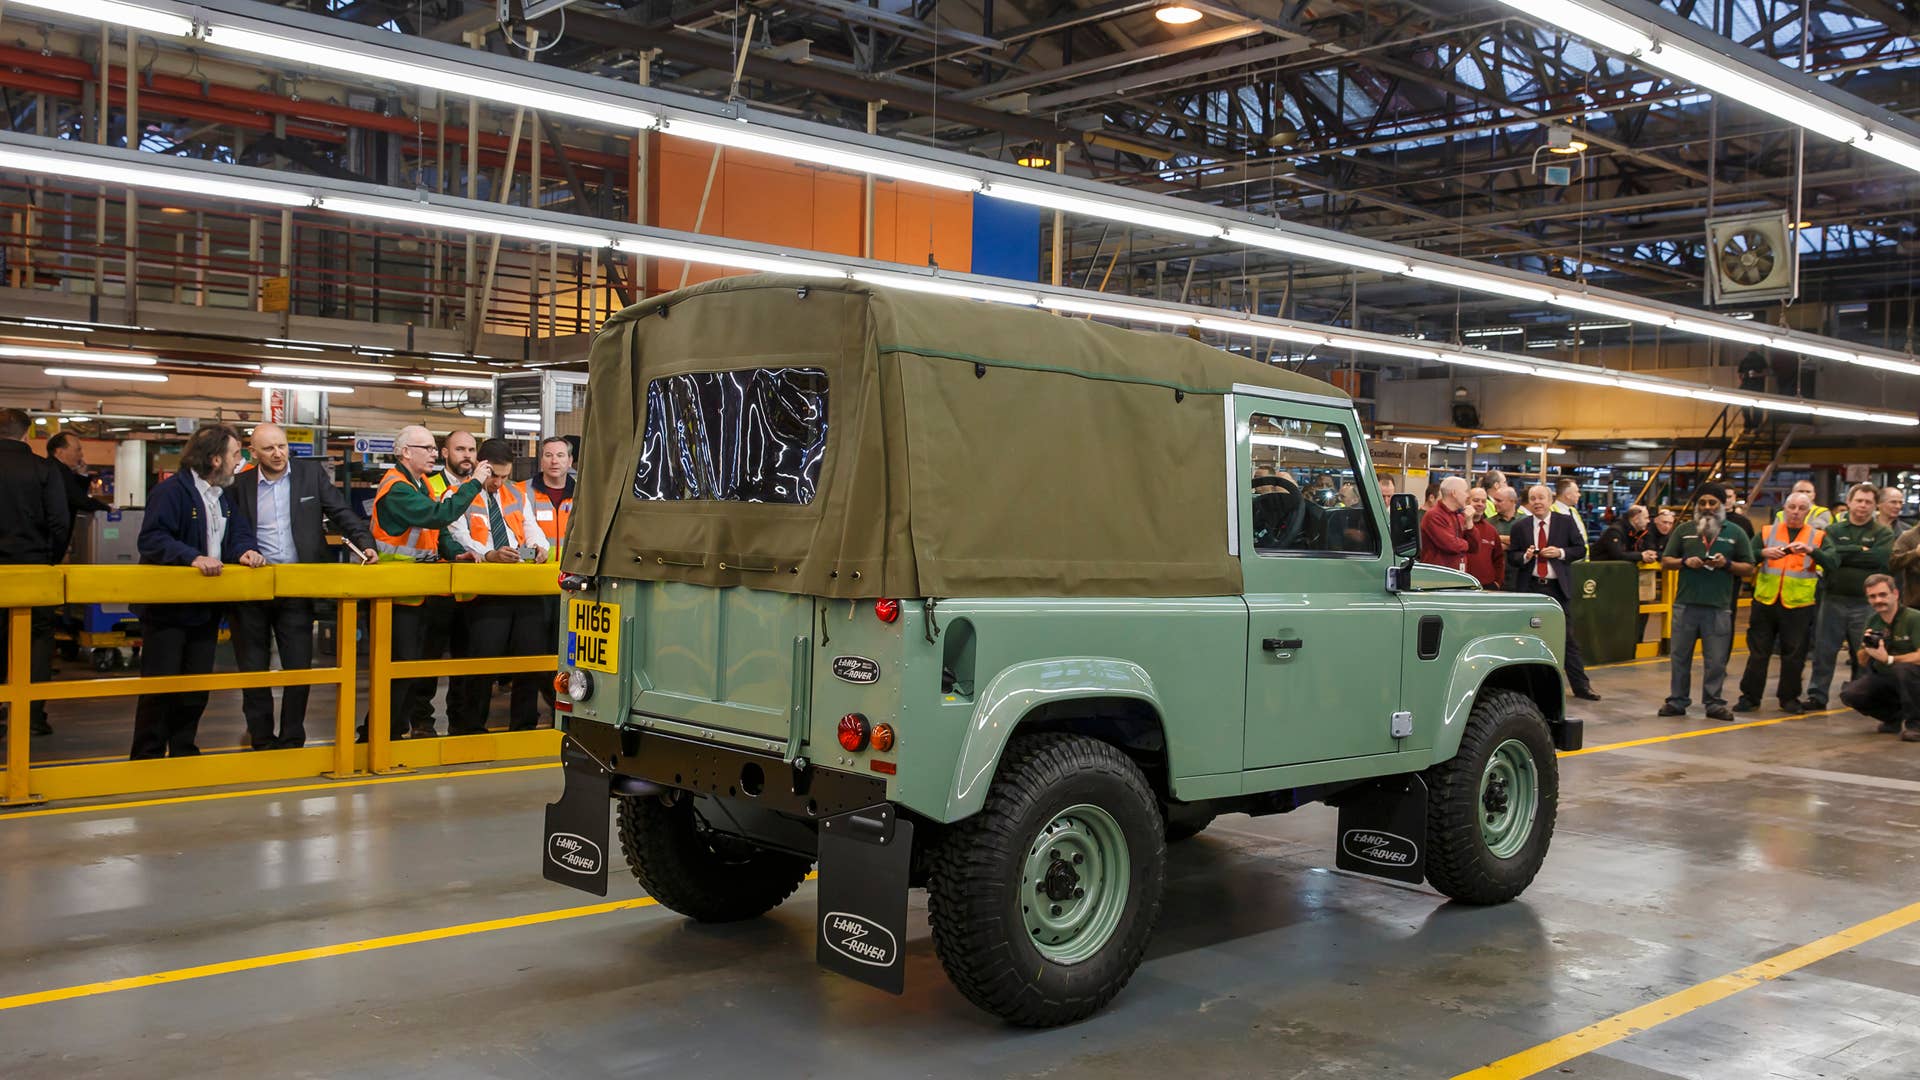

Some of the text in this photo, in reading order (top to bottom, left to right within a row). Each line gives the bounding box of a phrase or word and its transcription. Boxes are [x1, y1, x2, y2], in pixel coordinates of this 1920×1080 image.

[577, 634, 607, 665] HUE
[838, 658, 857, 668] LAND
[848, 670, 872, 680] ROVER
[556, 837, 578, 850] LAND
[1353, 833, 1383, 845] LAND
[567, 854, 594, 870] ROVER
[1369, 848, 1407, 863] ROVER
[833, 917, 862, 935] LAND
[849, 940, 886, 961] ROVER
